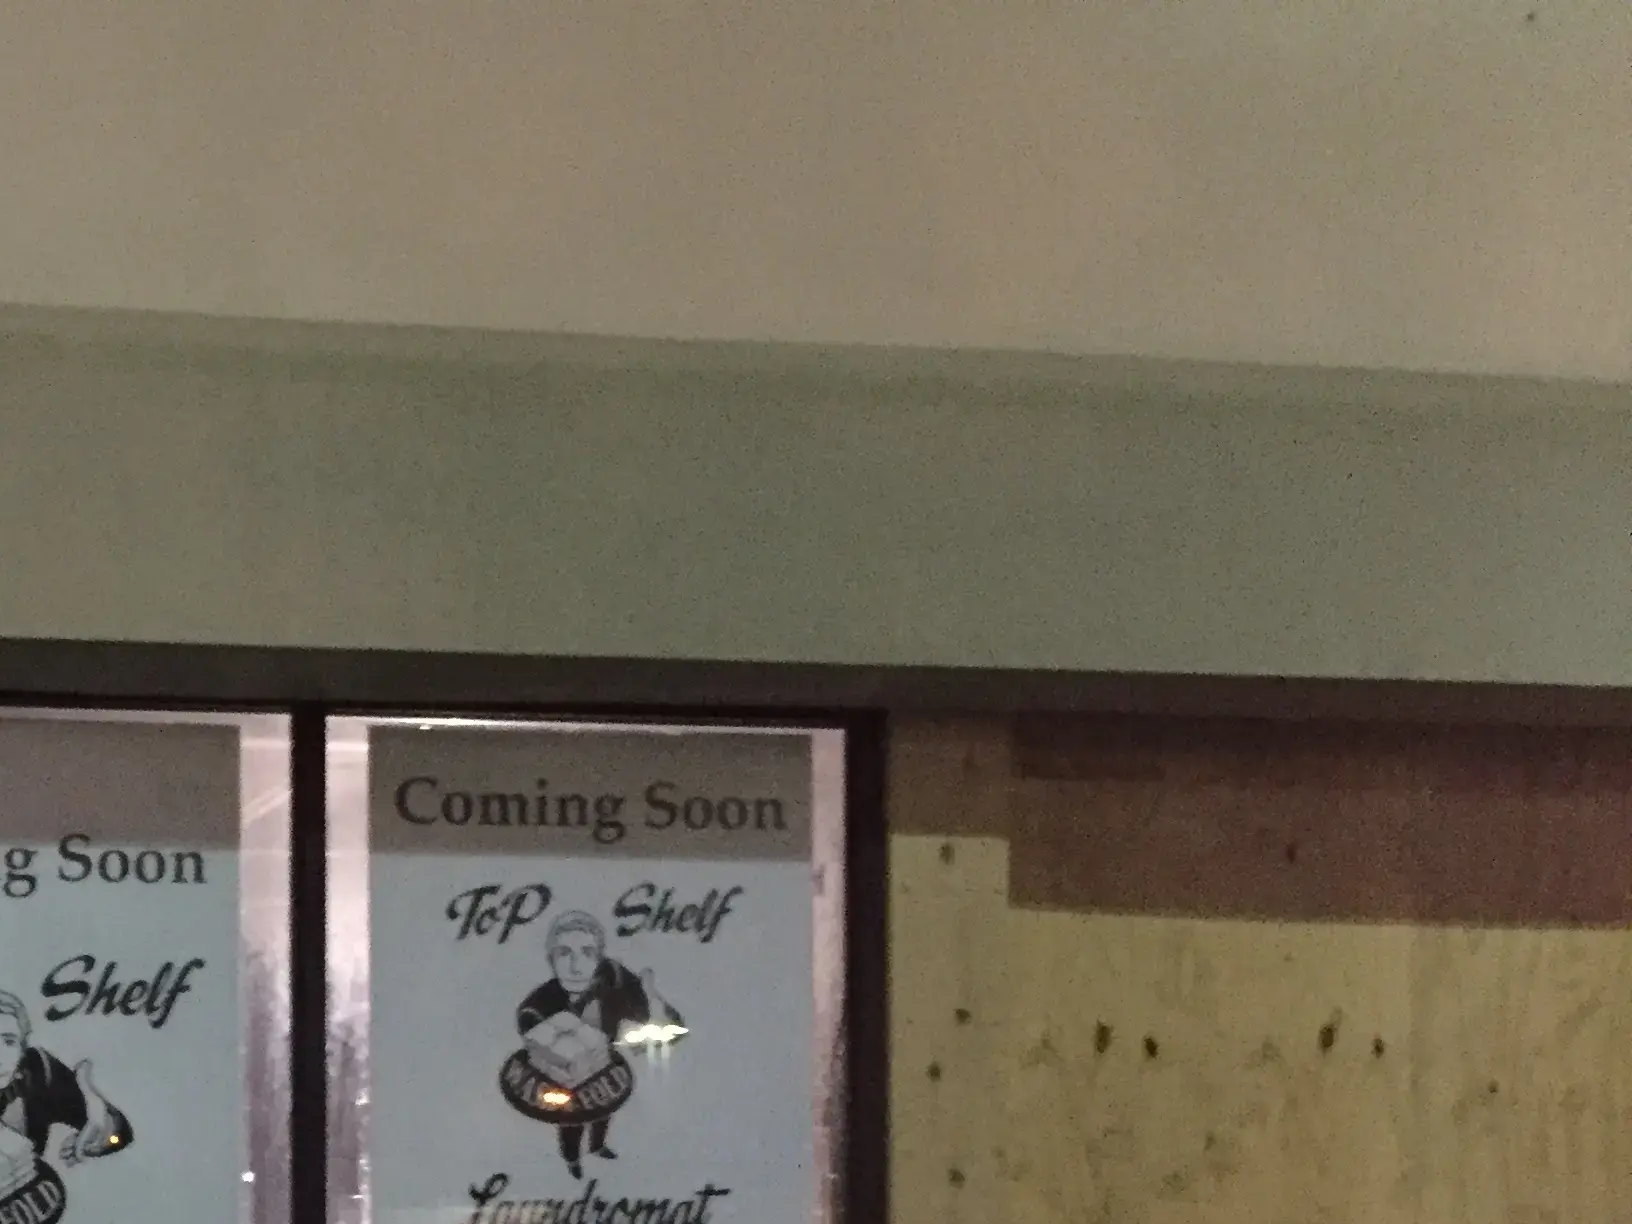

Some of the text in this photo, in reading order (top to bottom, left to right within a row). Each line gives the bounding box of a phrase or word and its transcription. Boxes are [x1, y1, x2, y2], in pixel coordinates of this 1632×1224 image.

[394, 776, 788, 845] Coming Soon
[57, 833, 207, 885] Soon
[613, 881, 744, 943] Shelf
[41, 953, 206, 1030] Shelf
